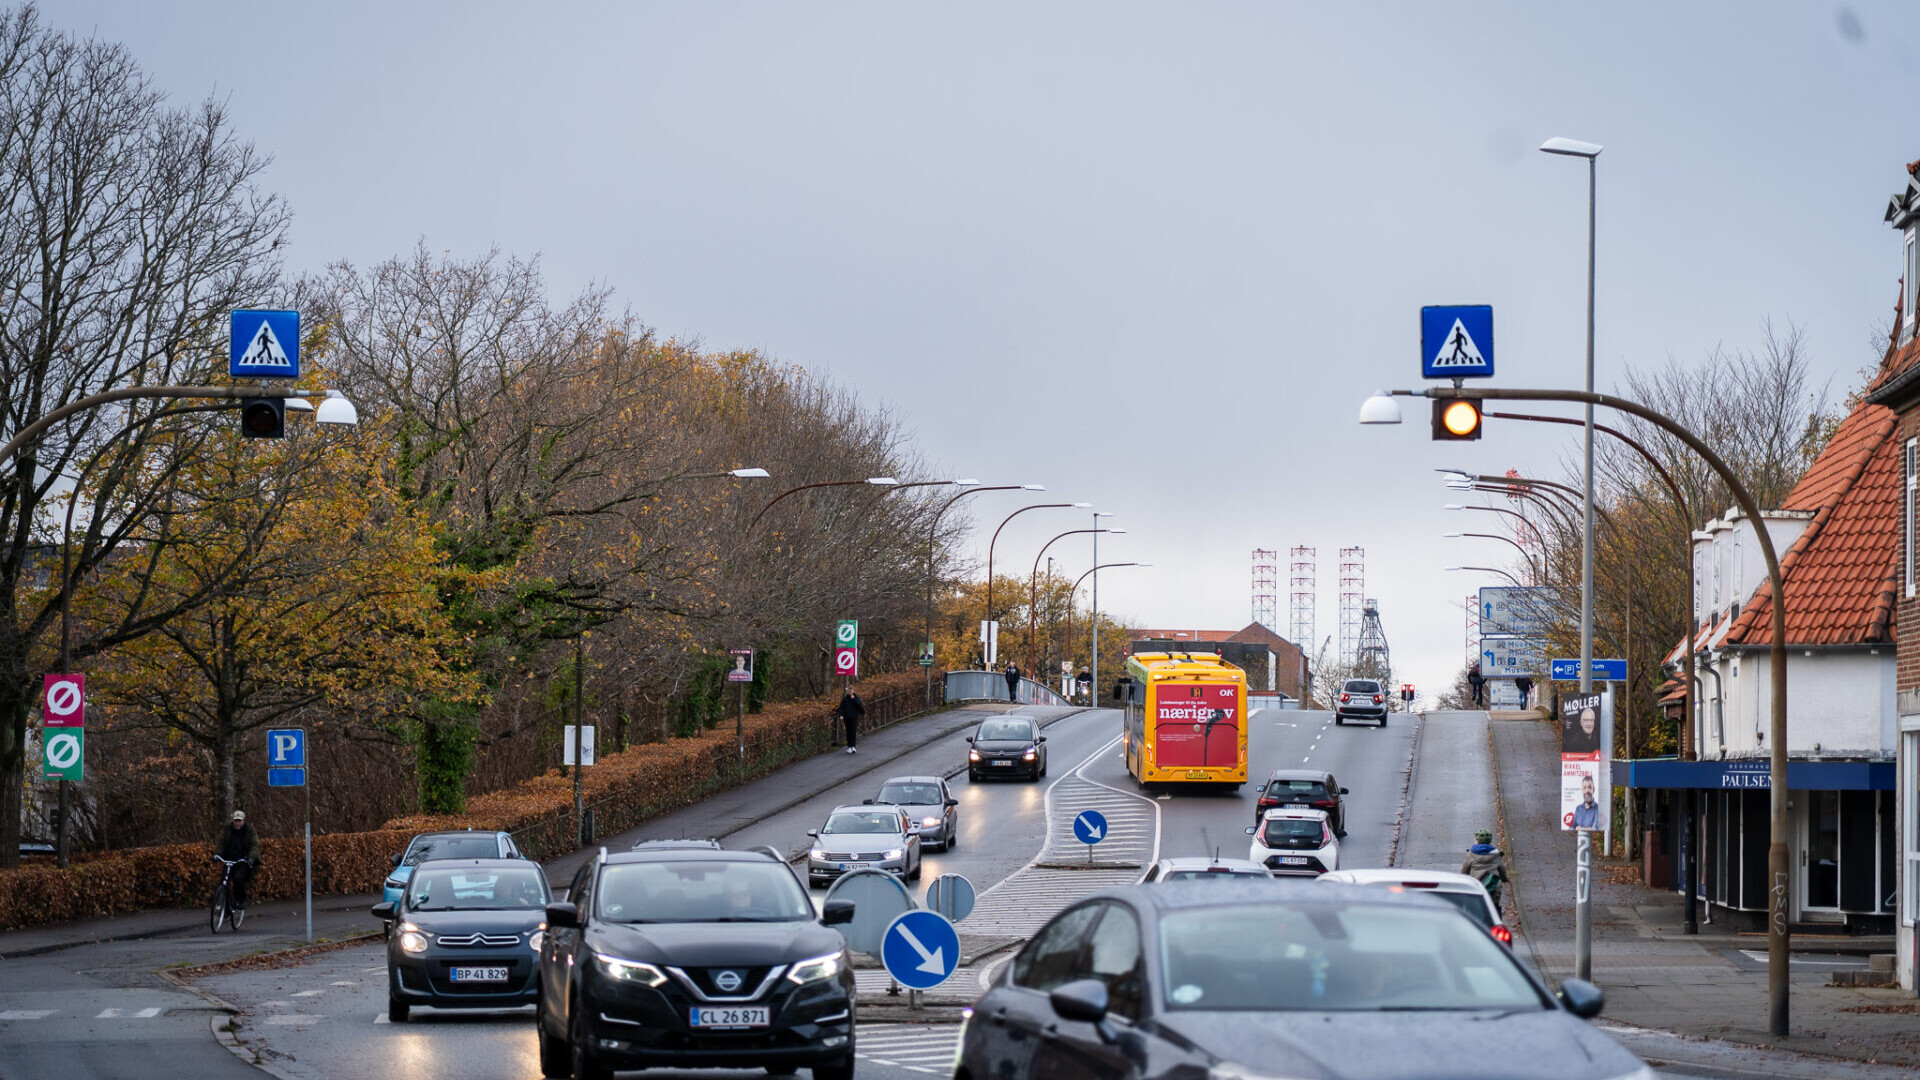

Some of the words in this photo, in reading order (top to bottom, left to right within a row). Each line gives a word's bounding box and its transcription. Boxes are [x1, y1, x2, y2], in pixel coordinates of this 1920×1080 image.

[1219, 689, 1234, 697] OK
[1563, 695, 1600, 713] MØLLER
[1159, 705, 1234, 722] nærigrv
[274, 735, 297, 761] P
[1565, 815, 1574, 824] SF
[457, 969, 472, 979] BP
[473, 969, 484, 979] 41
[487, 969, 506, 979] 829
[700, 1010, 718, 1023] CL
[722, 1010, 739, 1023] 26
[742, 1010, 765, 1023] 871
